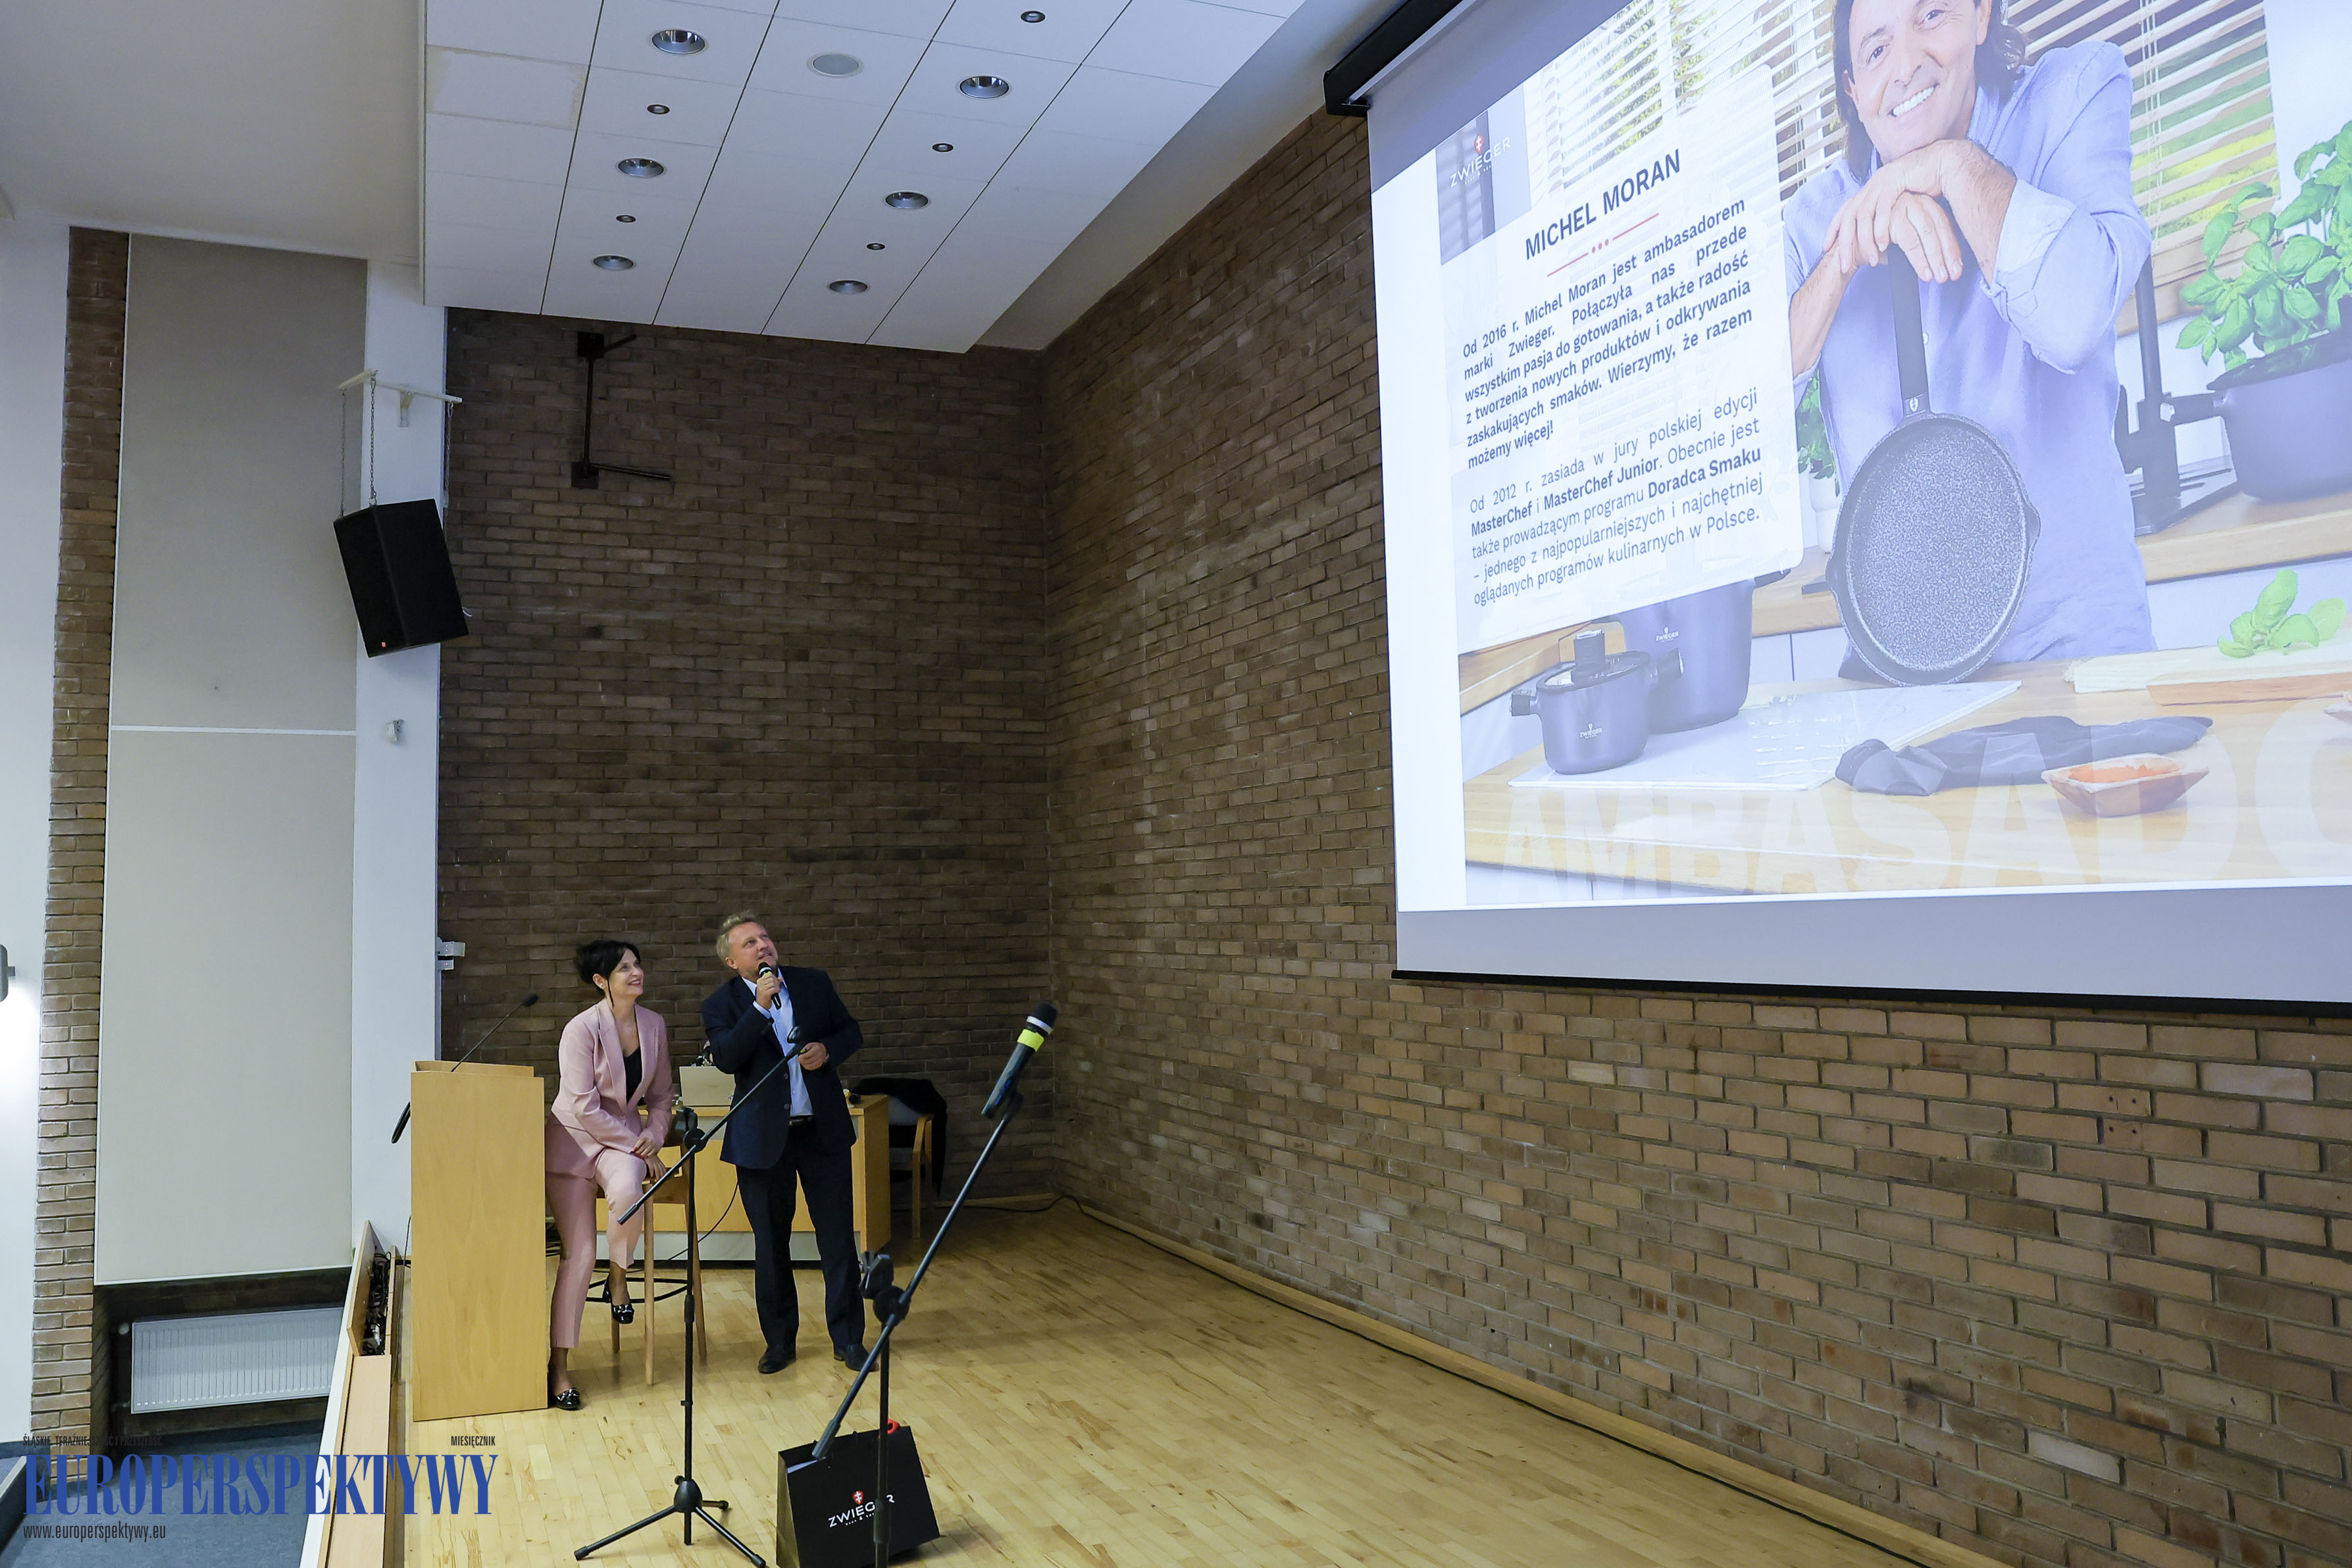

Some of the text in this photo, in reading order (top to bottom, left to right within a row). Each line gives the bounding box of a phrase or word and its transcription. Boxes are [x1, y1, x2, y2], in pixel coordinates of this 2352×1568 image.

[1449, 136, 1512, 189] ZWIEGER
[1525, 148, 1680, 261] MICHEL MORAN
[1463, 199, 1745, 358] Od 2016 r. Michel Moran jest ambasadorem
[1464, 226, 1747, 380] marki Zwieger. Połączyła nas przede
[1465, 249, 1749, 402] wszystkim pasja do gotowania, a także radość
[1466, 280, 1751, 424] z tworzenia nowych produktów i odkrywania
[1467, 309, 1752, 447] zaskakujących smaków. Wierzymy, że razem
[1468, 420, 1553, 469] możemy więcej!
[1470, 386, 1757, 513] Od 2012 r. zasiada w jury polskiej edycji
[1471, 417, 1760, 537] MasterChef i MasterChef Junior. Obecnie jest
[1472, 447, 1761, 559] także prowadzącym programu Doradca Smaku
[1474, 507, 1759, 607] oglądanych programów kulinarnych w Polsce.
[1484, 555, 1525, 583] jednego
[1531, 551, 1537, 564] z
[1543, 506, 1665, 560] najpopularniejszych
[1672, 501, 1675, 518] i
[1682, 471, 1763, 515] najchętniej
[828, 1494, 895, 1528] ZWIEGR
